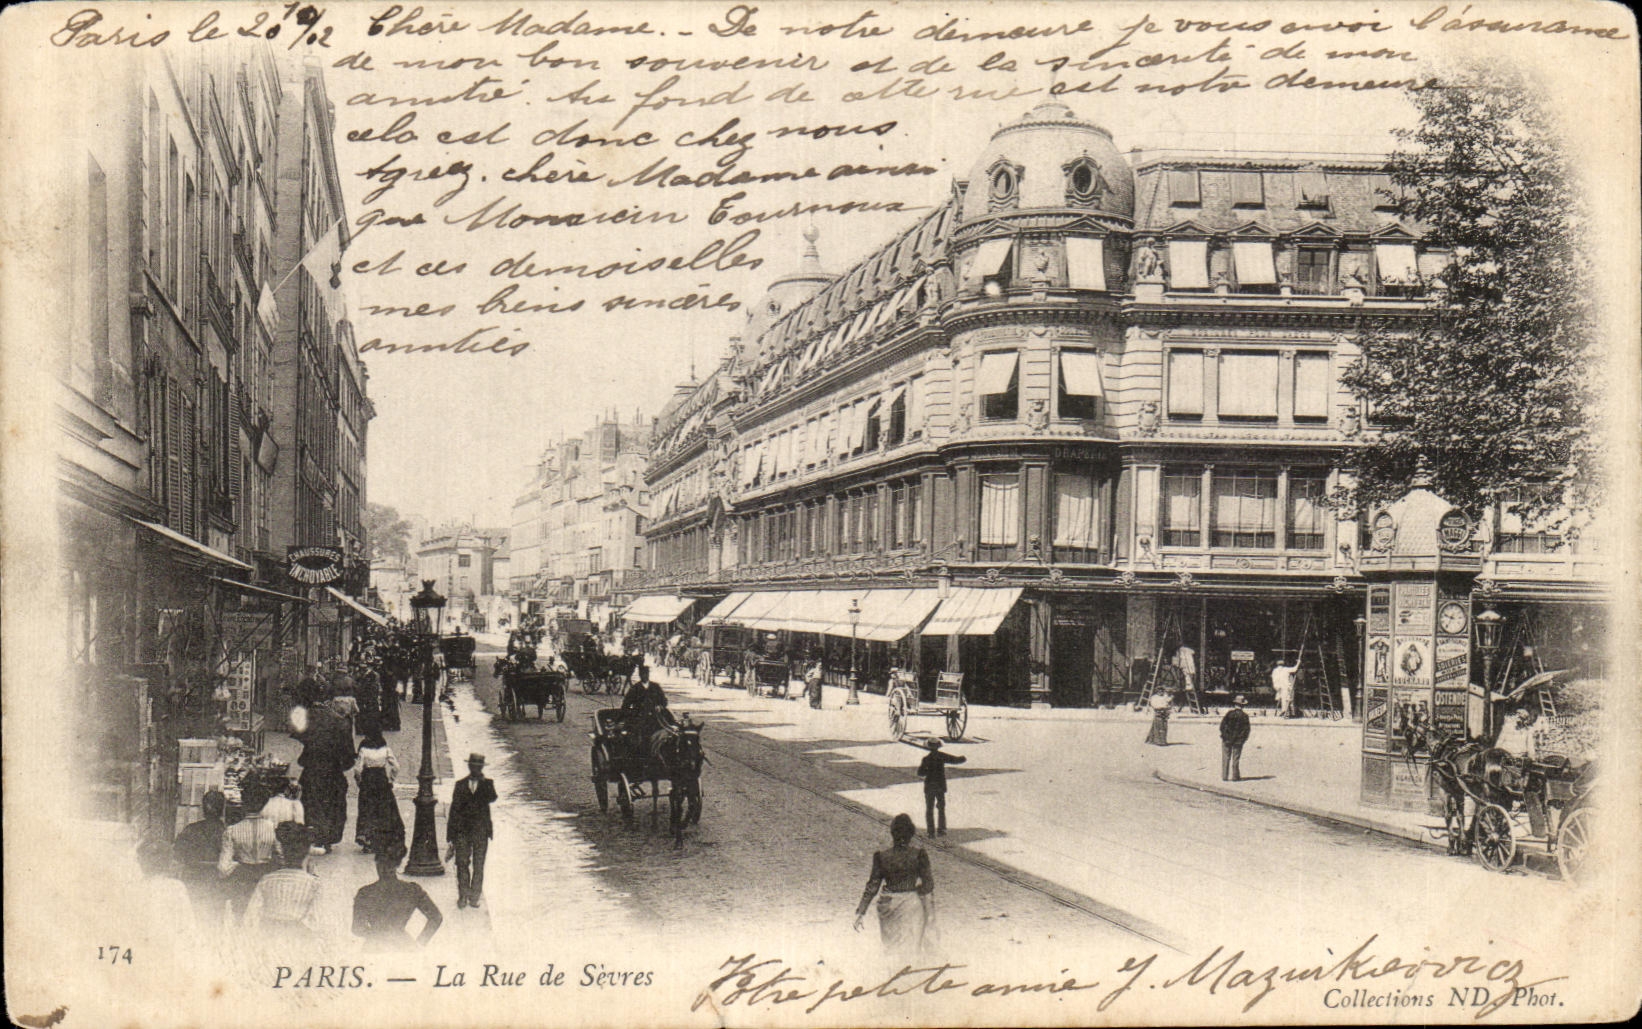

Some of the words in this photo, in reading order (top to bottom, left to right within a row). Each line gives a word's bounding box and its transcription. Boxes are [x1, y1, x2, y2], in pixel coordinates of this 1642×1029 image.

[50, 9, 171, 48] Paris
[187, 10, 228, 42] le
[708, 5, 759, 38] De
[780, 9, 894, 38] notre
[1175, 17, 1273, 34] vous
[332, 51, 374, 71] de
[393, 54, 503, 71] mon
[517, 40, 601, 71] bon
[625, 52, 829, 73] souvenir
[850, 55, 898, 74] et
[908, 55, 956, 76] de
[978, 51, 1018, 73] la
[1259, 40, 1306, 61] de
[1327, 47, 1418, 62] mon
[612, 75, 754, 131] fond
[765, 82, 815, 104] de
[347, 111, 419, 144] cela
[437, 122, 511, 145] est
[532, 119, 660, 147] donc
[675, 117, 757, 168] chez
[607, 156, 821, 188] Madame
[352, 250, 406, 276] et
[490, 228, 766, 278] demoiselles
[360, 303, 456, 318] mes
[806, 962, 969, 1014] petite
